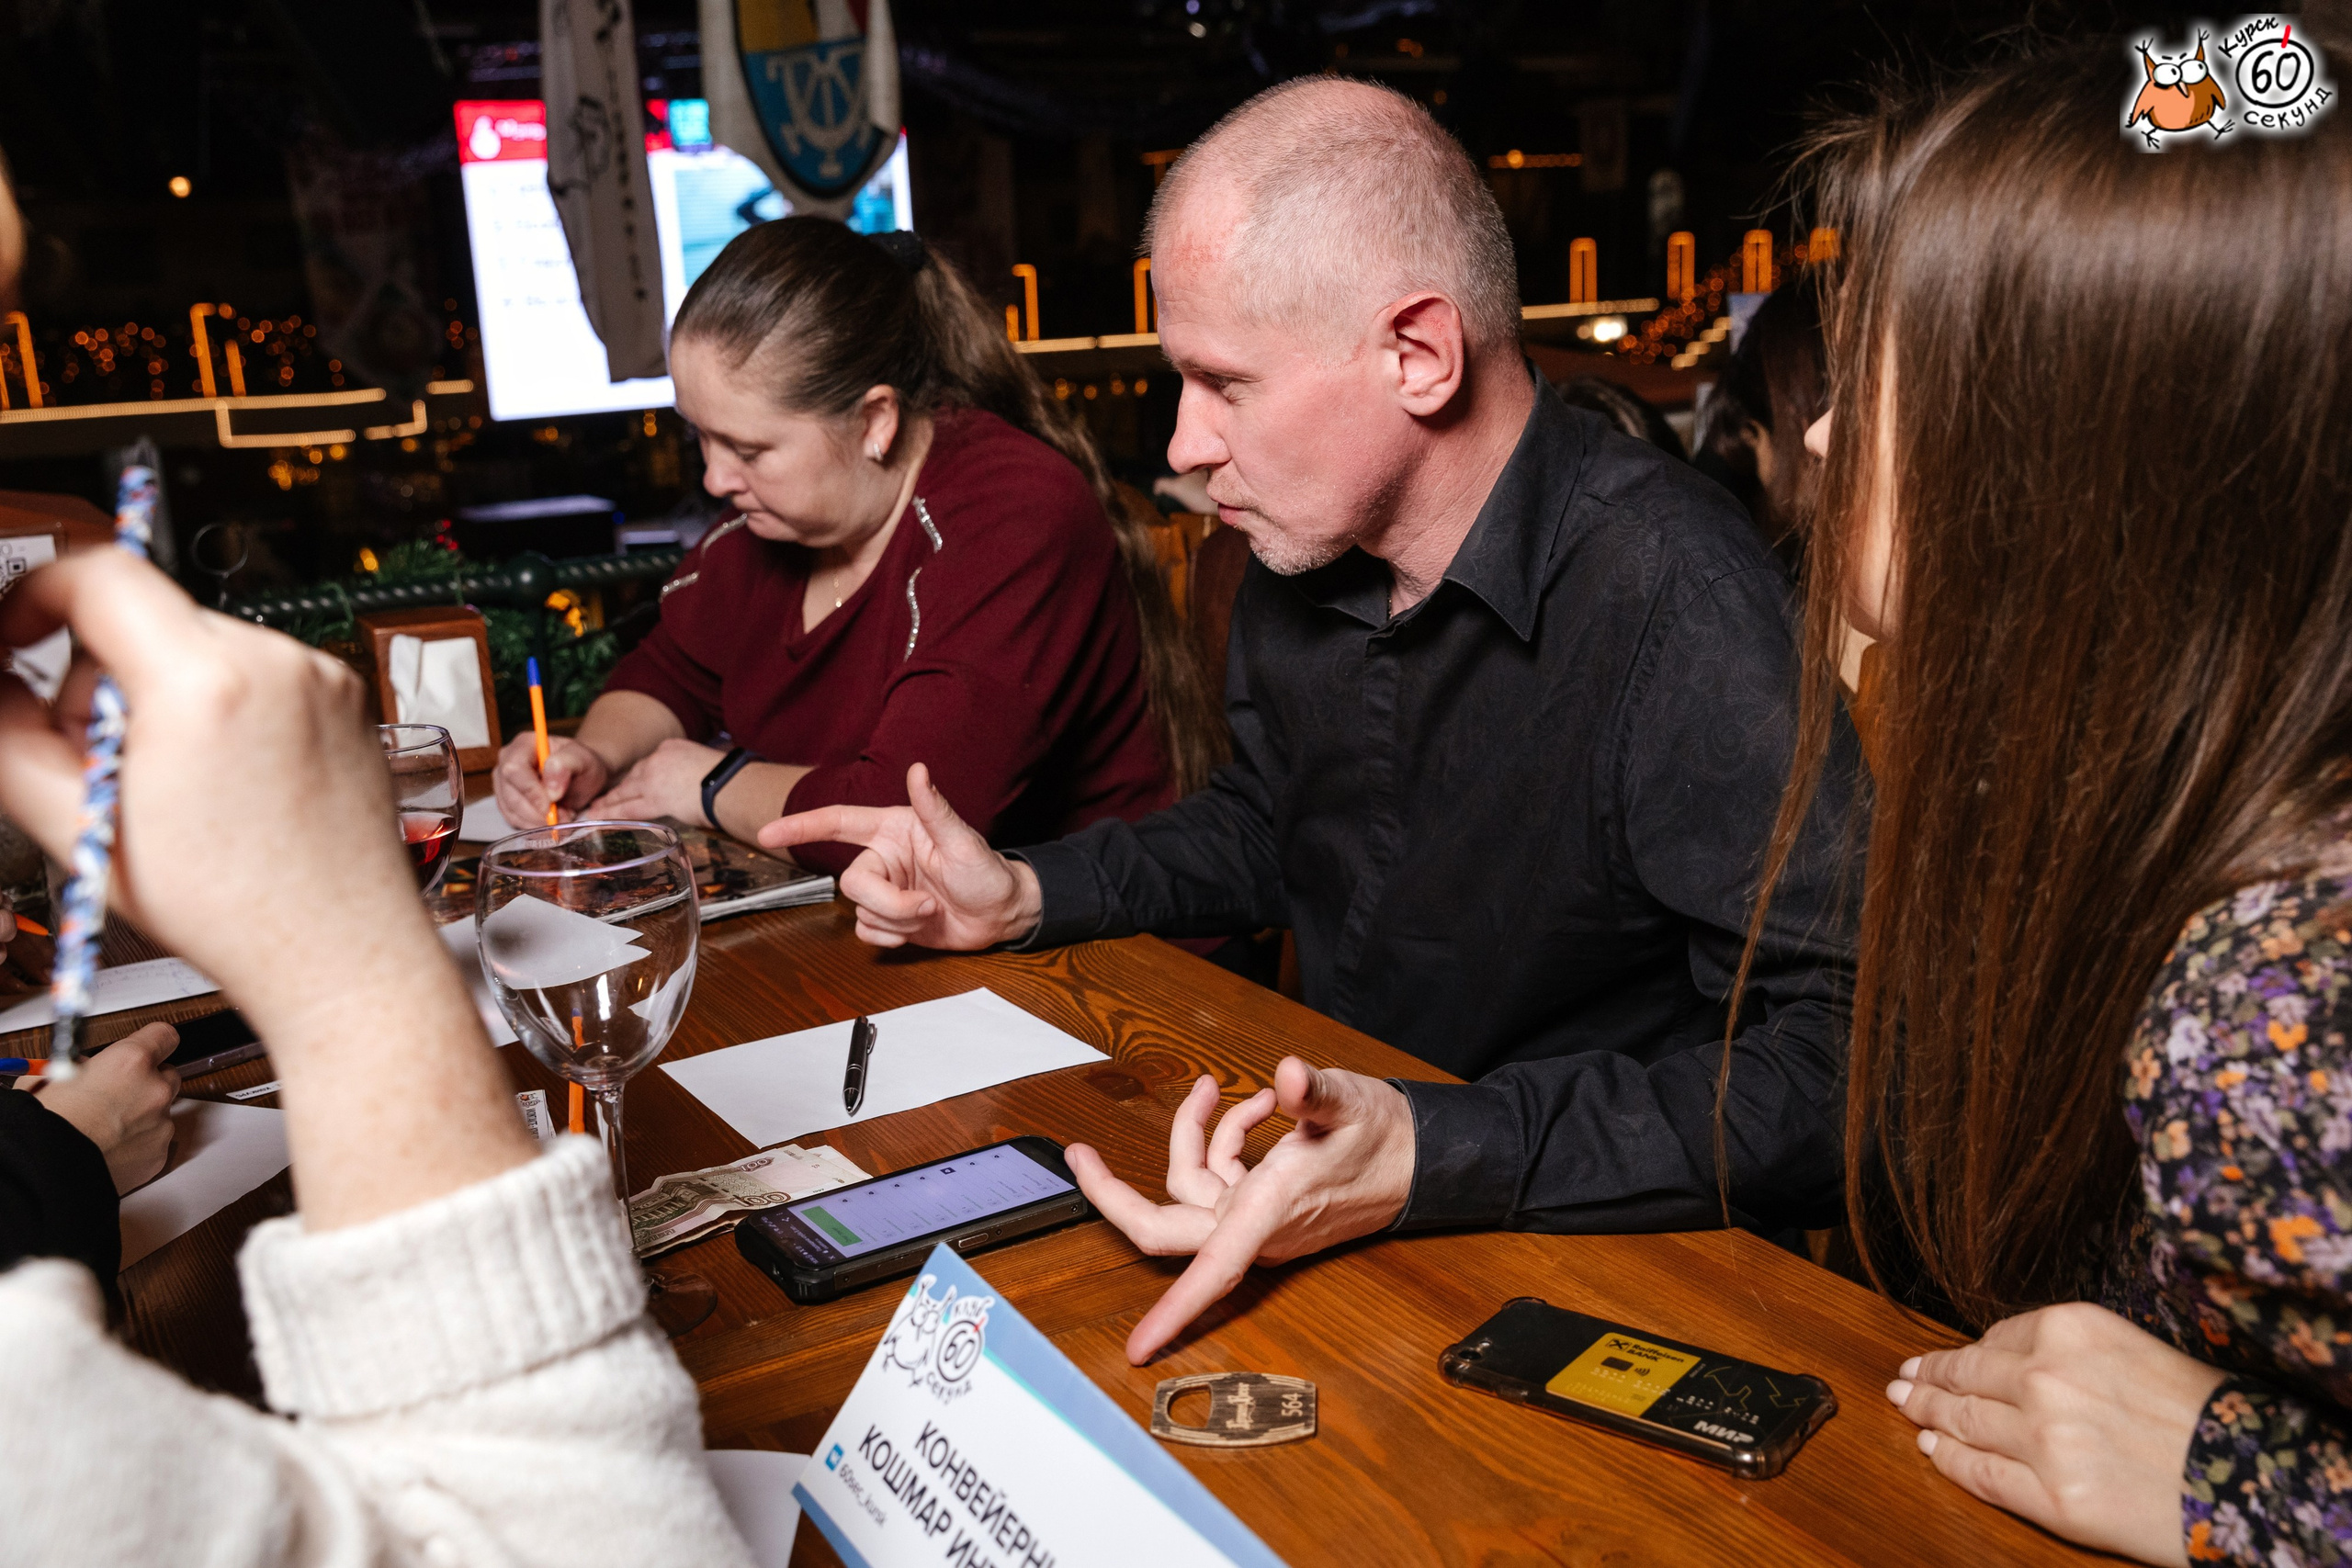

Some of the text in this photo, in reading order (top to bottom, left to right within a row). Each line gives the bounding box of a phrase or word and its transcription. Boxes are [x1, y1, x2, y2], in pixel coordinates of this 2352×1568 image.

[740, 1157, 768, 1172] 100
[736, 1191, 791, 1207] 100
[944, 1330, 976, 1370] 60
[1627, 1348, 1662, 1362] BANK
[1631, 1344, 1685, 1363] Raiffeisen
[1281, 1393, 1304, 1417] 564
[1693, 1420, 1756, 1444] МИР
[858, 1424, 997, 1568] КОШМАР ИН
